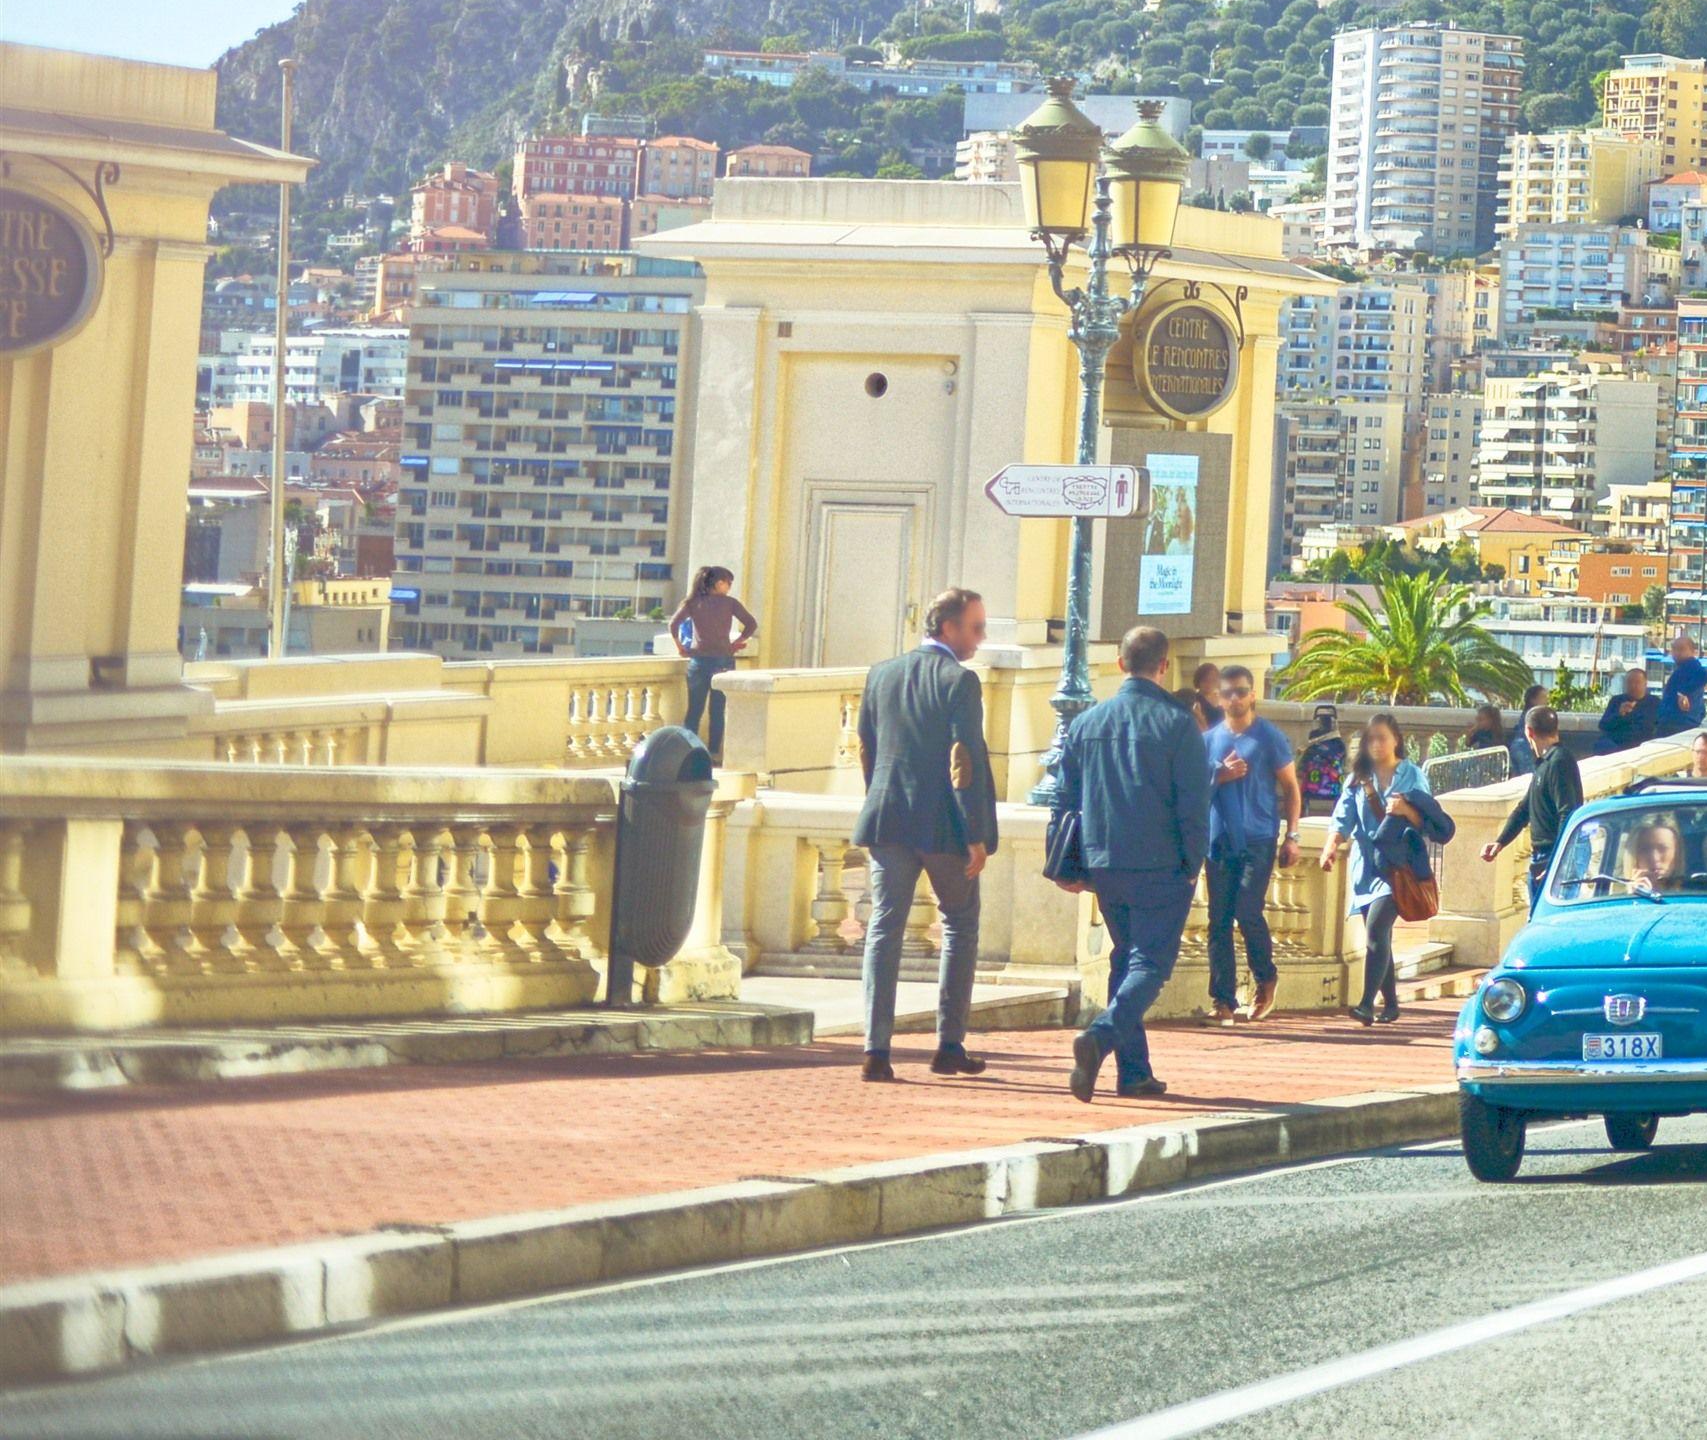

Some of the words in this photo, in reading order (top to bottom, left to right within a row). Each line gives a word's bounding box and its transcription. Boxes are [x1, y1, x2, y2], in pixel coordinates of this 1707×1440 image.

[1169, 317, 1208, 340] CENTRE
[1163, 346, 1228, 371] RENCONTRES
[1151, 374, 1223, 396] NTERNATIONALES
[1604, 1037, 1658, 1058] 318X
